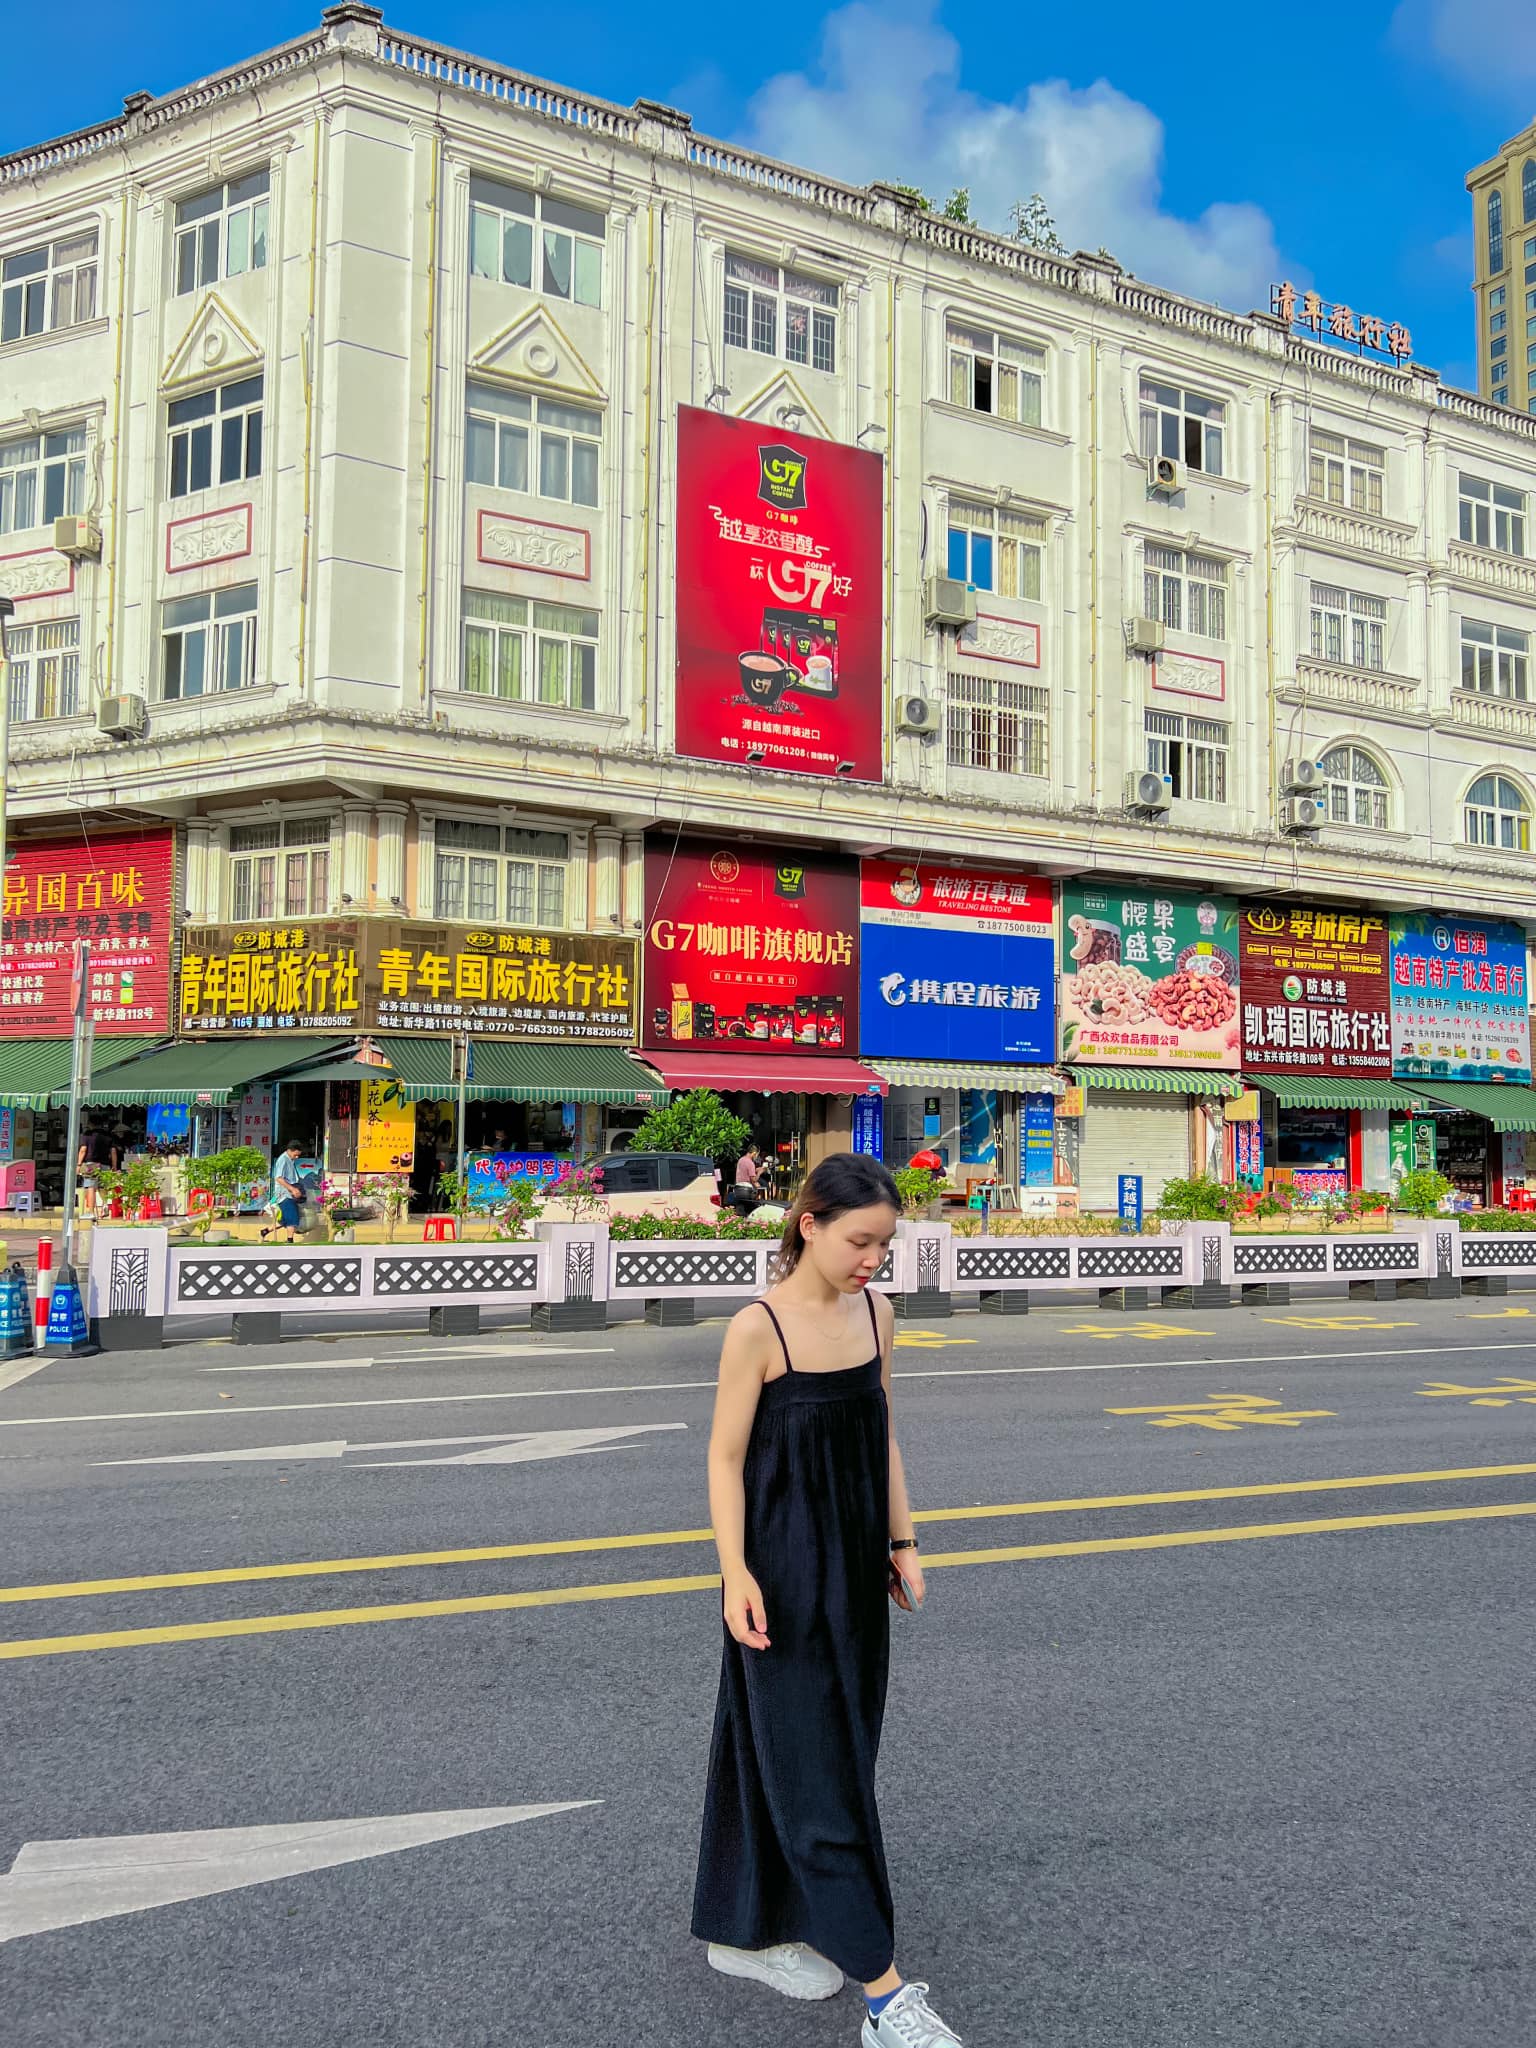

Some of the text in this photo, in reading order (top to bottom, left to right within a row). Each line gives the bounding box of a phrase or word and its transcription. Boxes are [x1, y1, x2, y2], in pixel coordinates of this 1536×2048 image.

[1272, 280, 1413, 355] 青年旅行社
[763, 459, 802, 487] G7
[718, 515, 814, 554] 越享浓香醇
[768, 559, 833, 609] G7
[832, 575, 853, 597] 好
[750, 677, 774, 695] G7
[741, 718, 821, 740] 源自越南原装进口
[777, 867, 803, 885] G7
[3, 868, 147, 916] 异国百味
[929, 876, 1031, 907] 旅游百事通
[938, 900, 1013, 914] TRAVELING BESTONE
[1122, 899, 1175, 930] 腰果
[76, 914, 110, 936] 批发
[117, 912, 152, 933] 零售
[1288, 909, 1384, 945] 翠城房产
[258, 929, 306, 949] 防城港
[499, 934, 552, 956] 防城港
[651, 919, 854, 966] G7咖啡旗舰店
[1124, 931, 1177, 964] 盛宴
[1453, 929, 1488, 956] 佰润
[93, 972, 115, 986] 微信
[181, 949, 359, 1016] 青年国际旅行社
[378, 948, 630, 1008] 青年国际旅行社
[1306, 978, 1347, 996] 防城港
[1393, 953, 1525, 998] 越南特产批发商行
[908, 979, 1041, 1010] 携程旅游
[1395, 996, 1526, 1017] 主营 越南特产 海鲜干货 送礼佳品
[93, 1007, 154, 1021] 新华路118号
[232, 1016, 253, 1028] 116号
[300, 1016, 352, 1027] 13788205092
[1244, 1003, 1391, 1052] 凯瑞国际旅行社
[568, 1025, 635, 1038] 13788205092
[49, 1325, 70, 1333] POLICE
